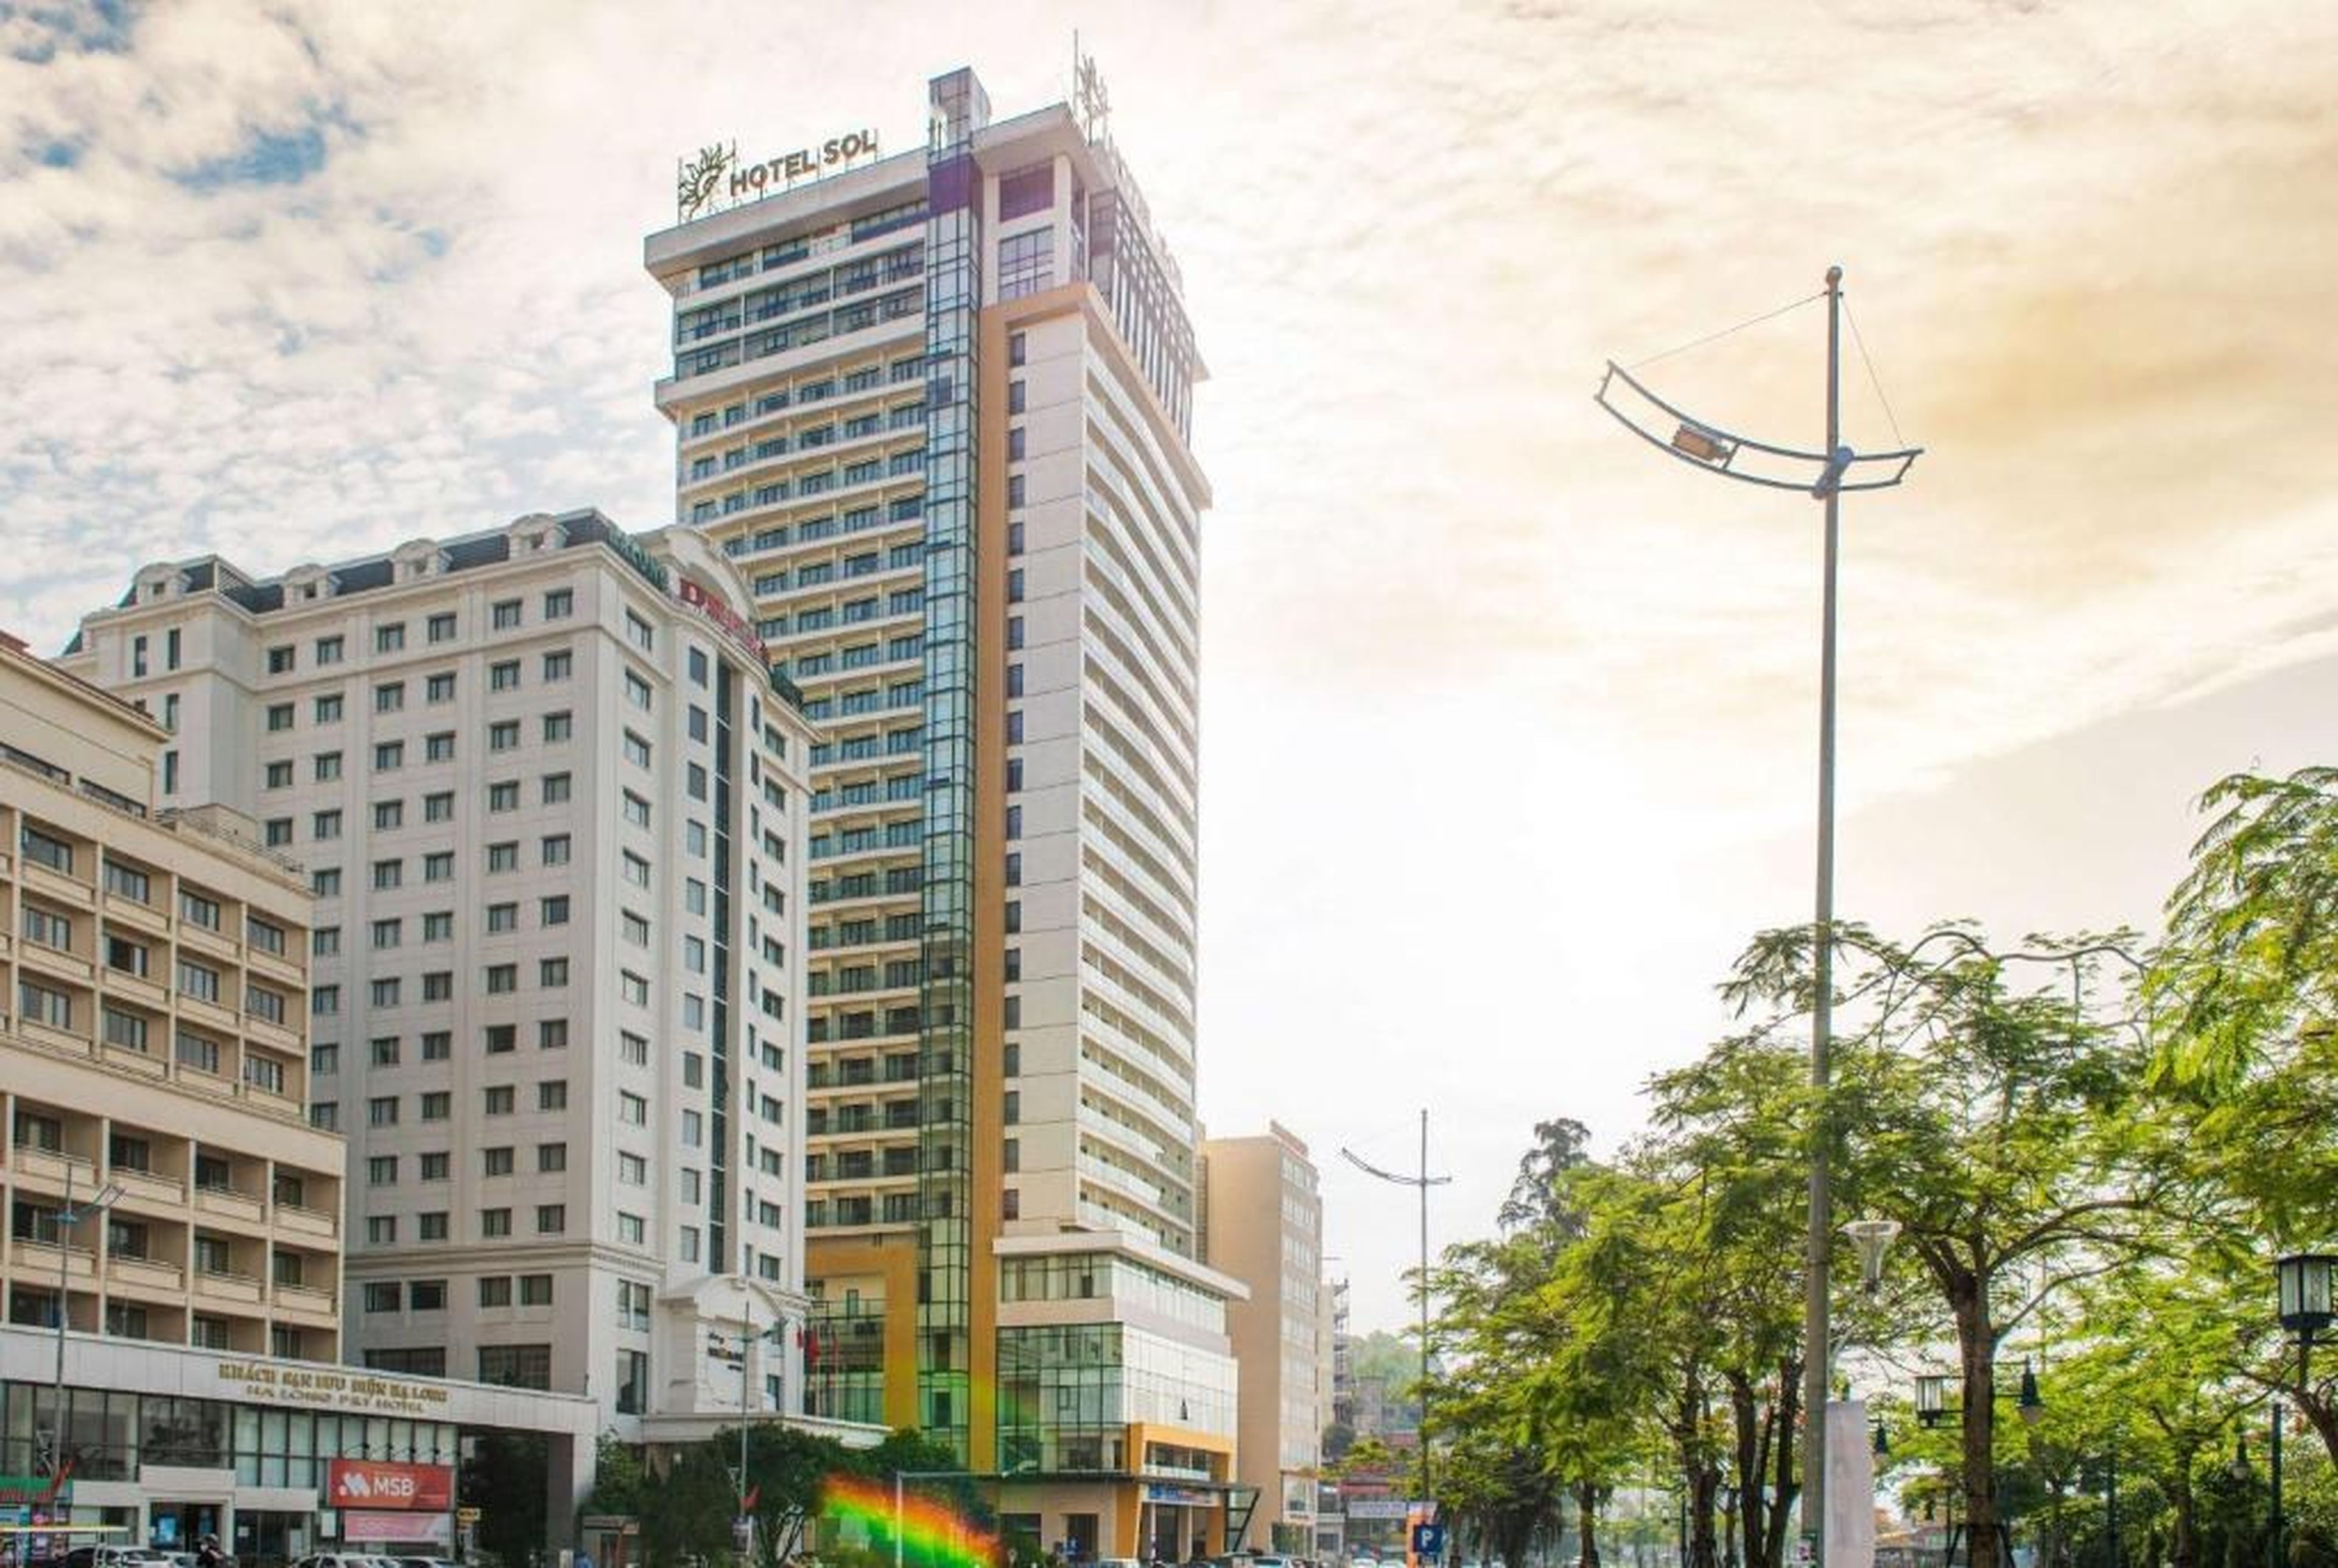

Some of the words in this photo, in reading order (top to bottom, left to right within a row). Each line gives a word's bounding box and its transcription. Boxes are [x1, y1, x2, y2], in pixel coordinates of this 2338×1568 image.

[730, 150, 816, 196] HOTEL
[824, 129, 877, 164] SOL
[373, 1477, 415, 1497] MSB
[1421, 1529, 1434, 1547] P
